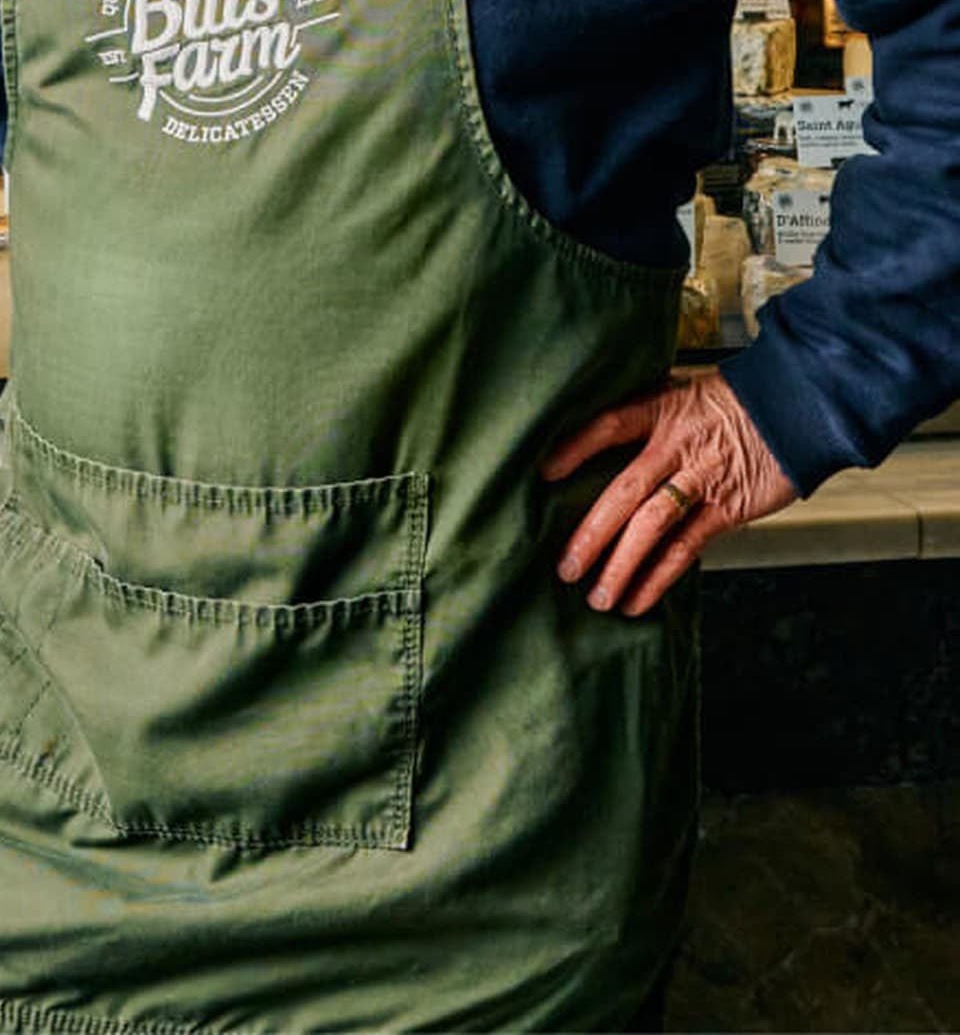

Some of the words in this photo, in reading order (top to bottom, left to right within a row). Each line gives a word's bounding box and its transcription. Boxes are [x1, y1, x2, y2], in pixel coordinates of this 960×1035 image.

[136, 20, 302, 122] Farm
[161, 70, 310, 144] DELICATESSEN
[797, 120, 831, 132] Saint
[836, 120, 861, 132] Ag
[777, 214, 830, 228] D'Affino
